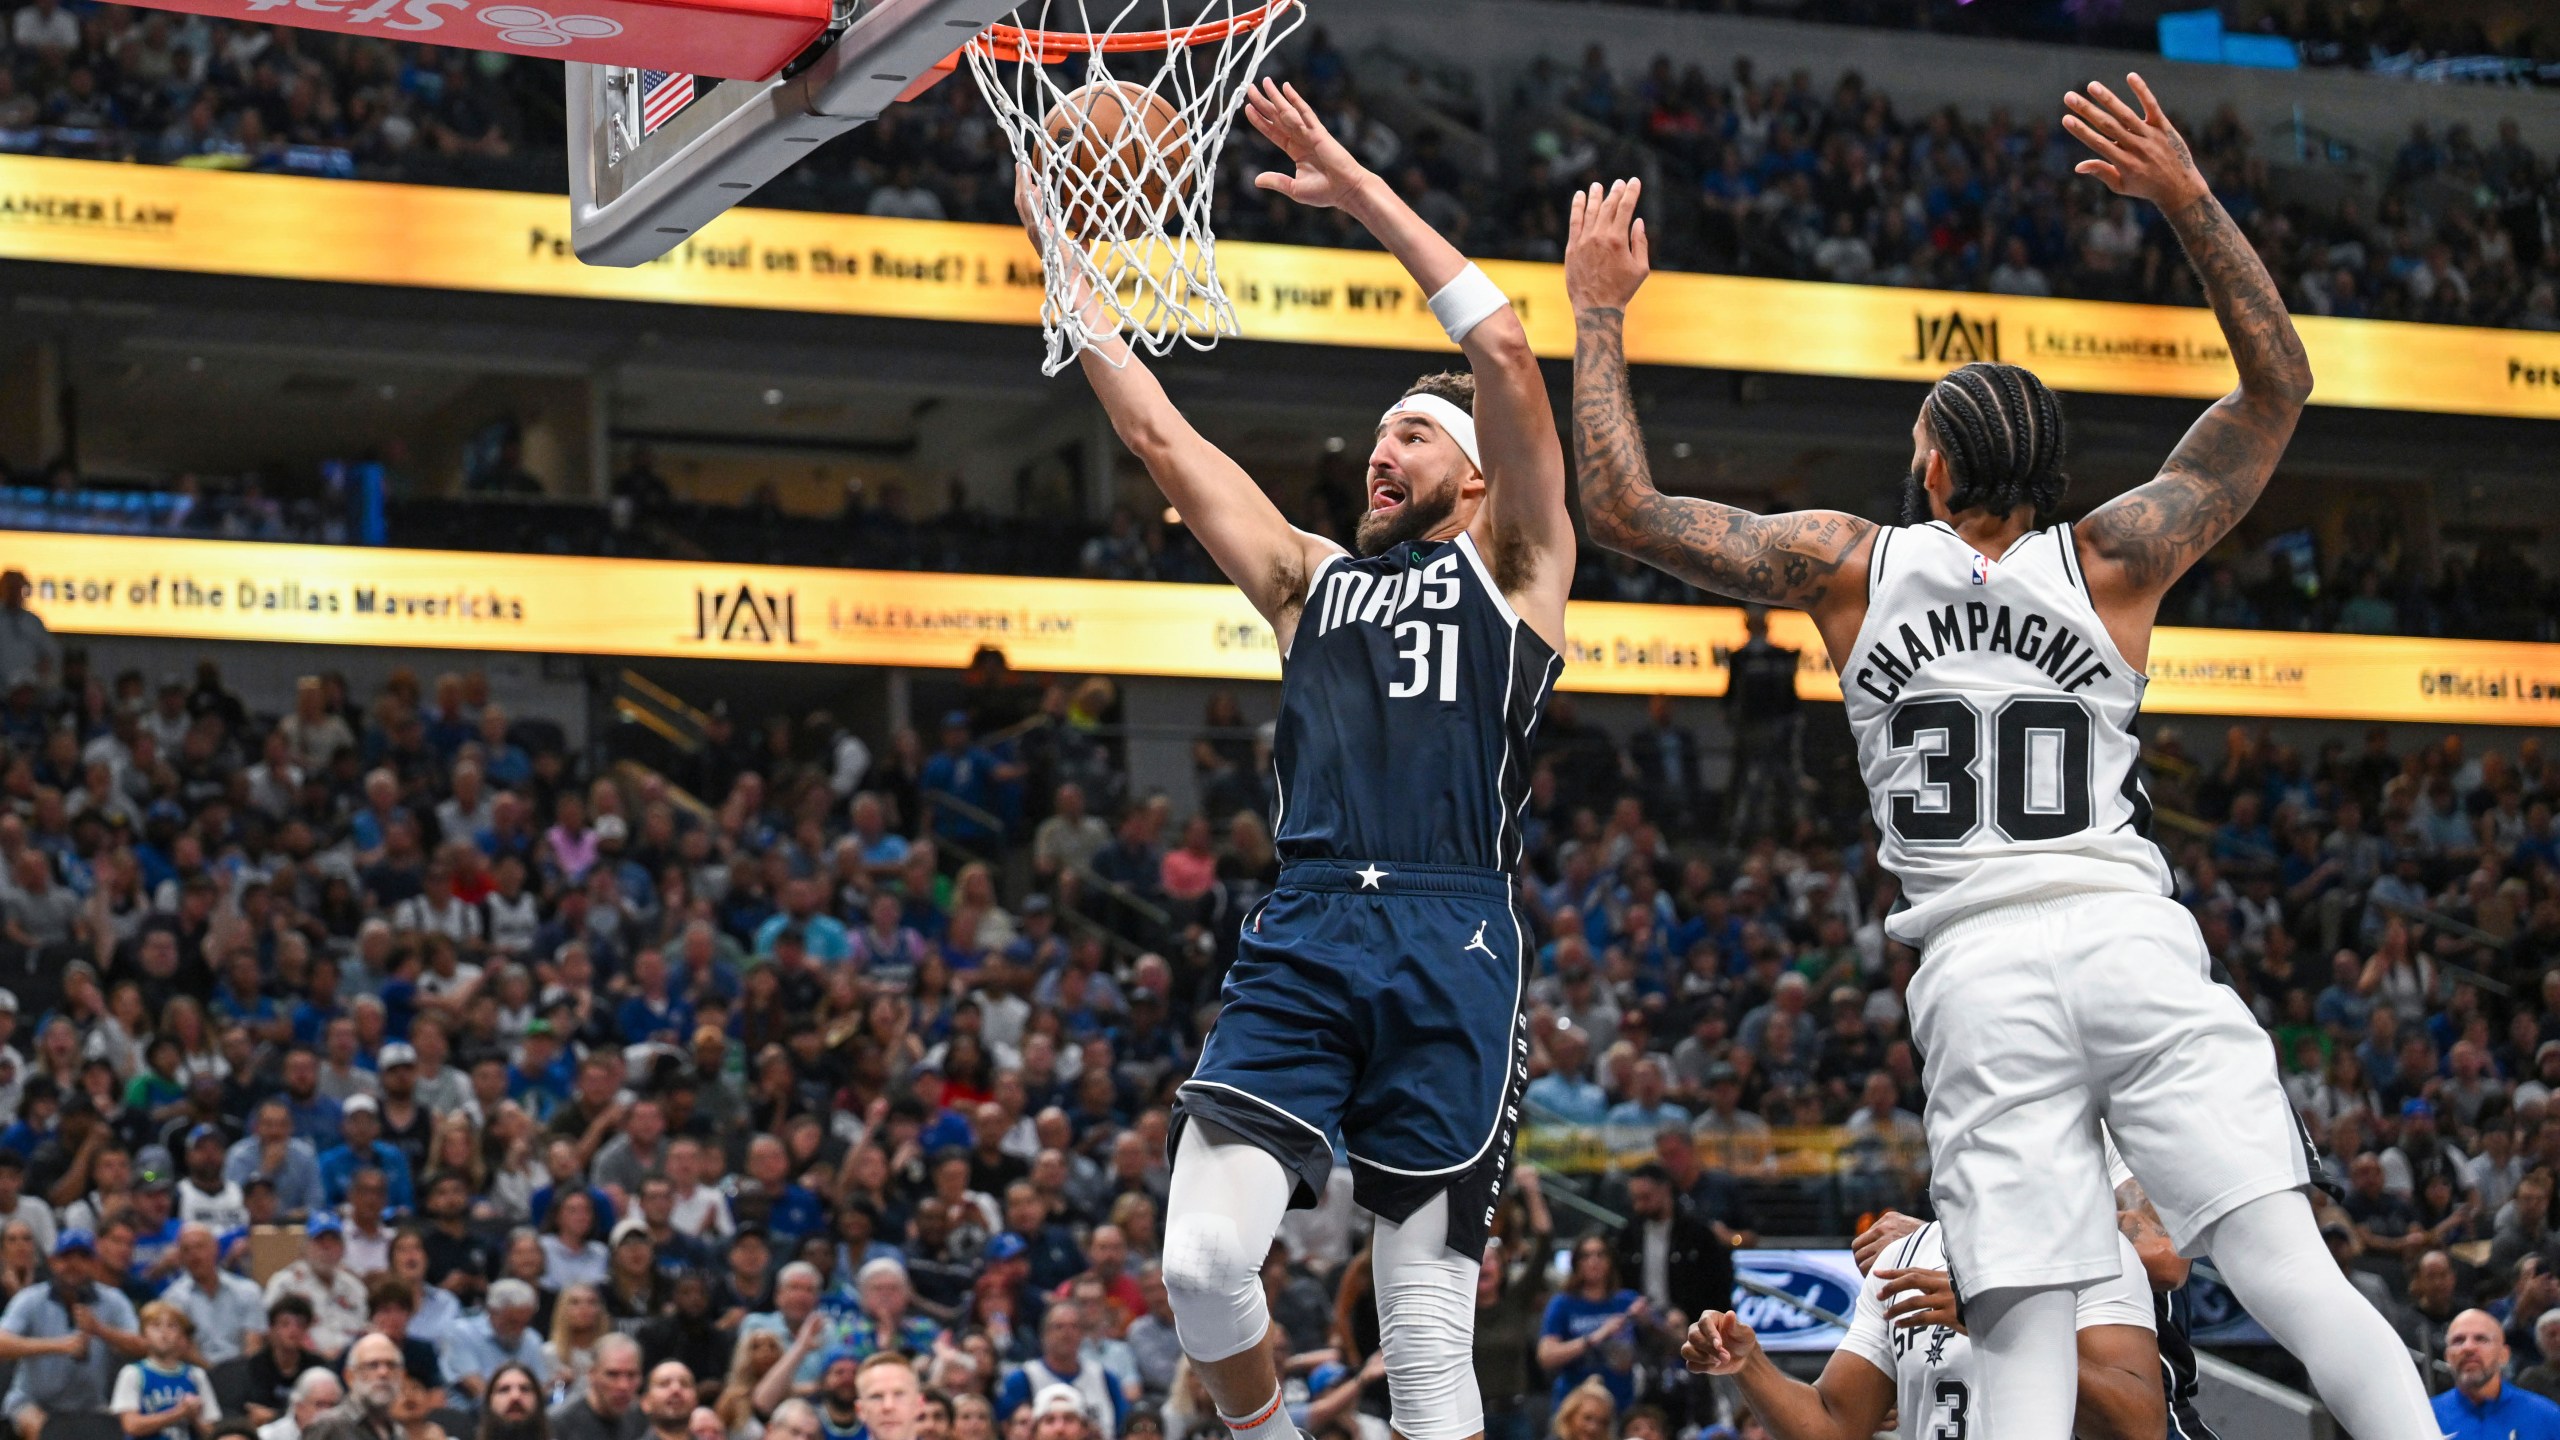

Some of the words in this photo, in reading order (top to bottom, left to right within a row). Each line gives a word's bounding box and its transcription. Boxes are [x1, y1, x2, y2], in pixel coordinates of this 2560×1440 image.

[765, 251, 796, 271] on
[1348, 285, 1402, 308] MVP
[130, 576, 160, 604] of
[171, 579, 223, 608] the
[238, 580, 339, 612] Dallas
[355, 584, 523, 620] Mavericks
[1389, 620, 1459, 702] 31
[1616, 640, 1698, 666] Dallas
[1857, 601, 2112, 704] CHAMPAGNIE
[2420, 672, 2508, 698] Official
[1887, 693, 2097, 847] 30
[1730, 1269, 1823, 1330] Ford
[1934, 1377, 1971, 1440] 3
